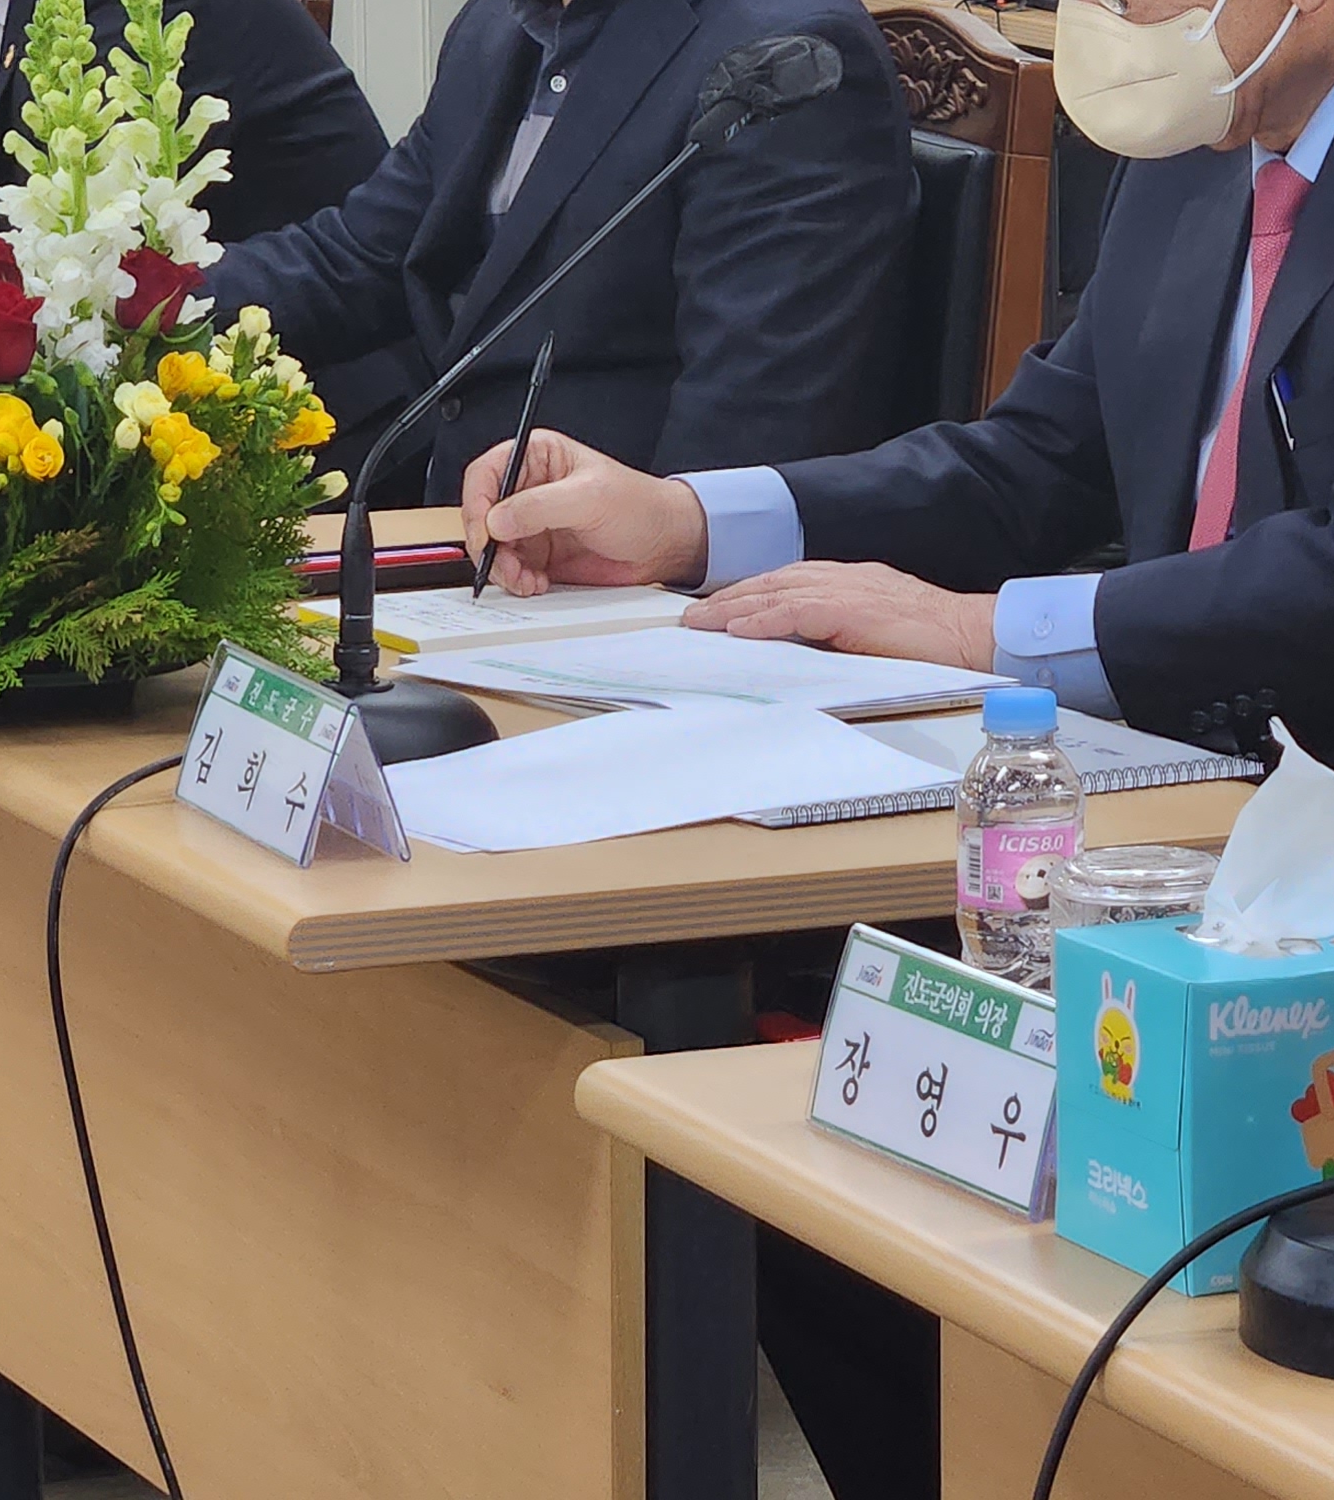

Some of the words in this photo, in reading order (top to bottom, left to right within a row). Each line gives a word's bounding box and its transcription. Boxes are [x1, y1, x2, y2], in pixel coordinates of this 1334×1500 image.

[902, 970, 974, 1026] 진도군의회
[974, 998, 1008, 1039] 의장
[1209, 995, 1330, 1041] Kleenex
[1087, 1159, 1149, 1210] 크리넥스
